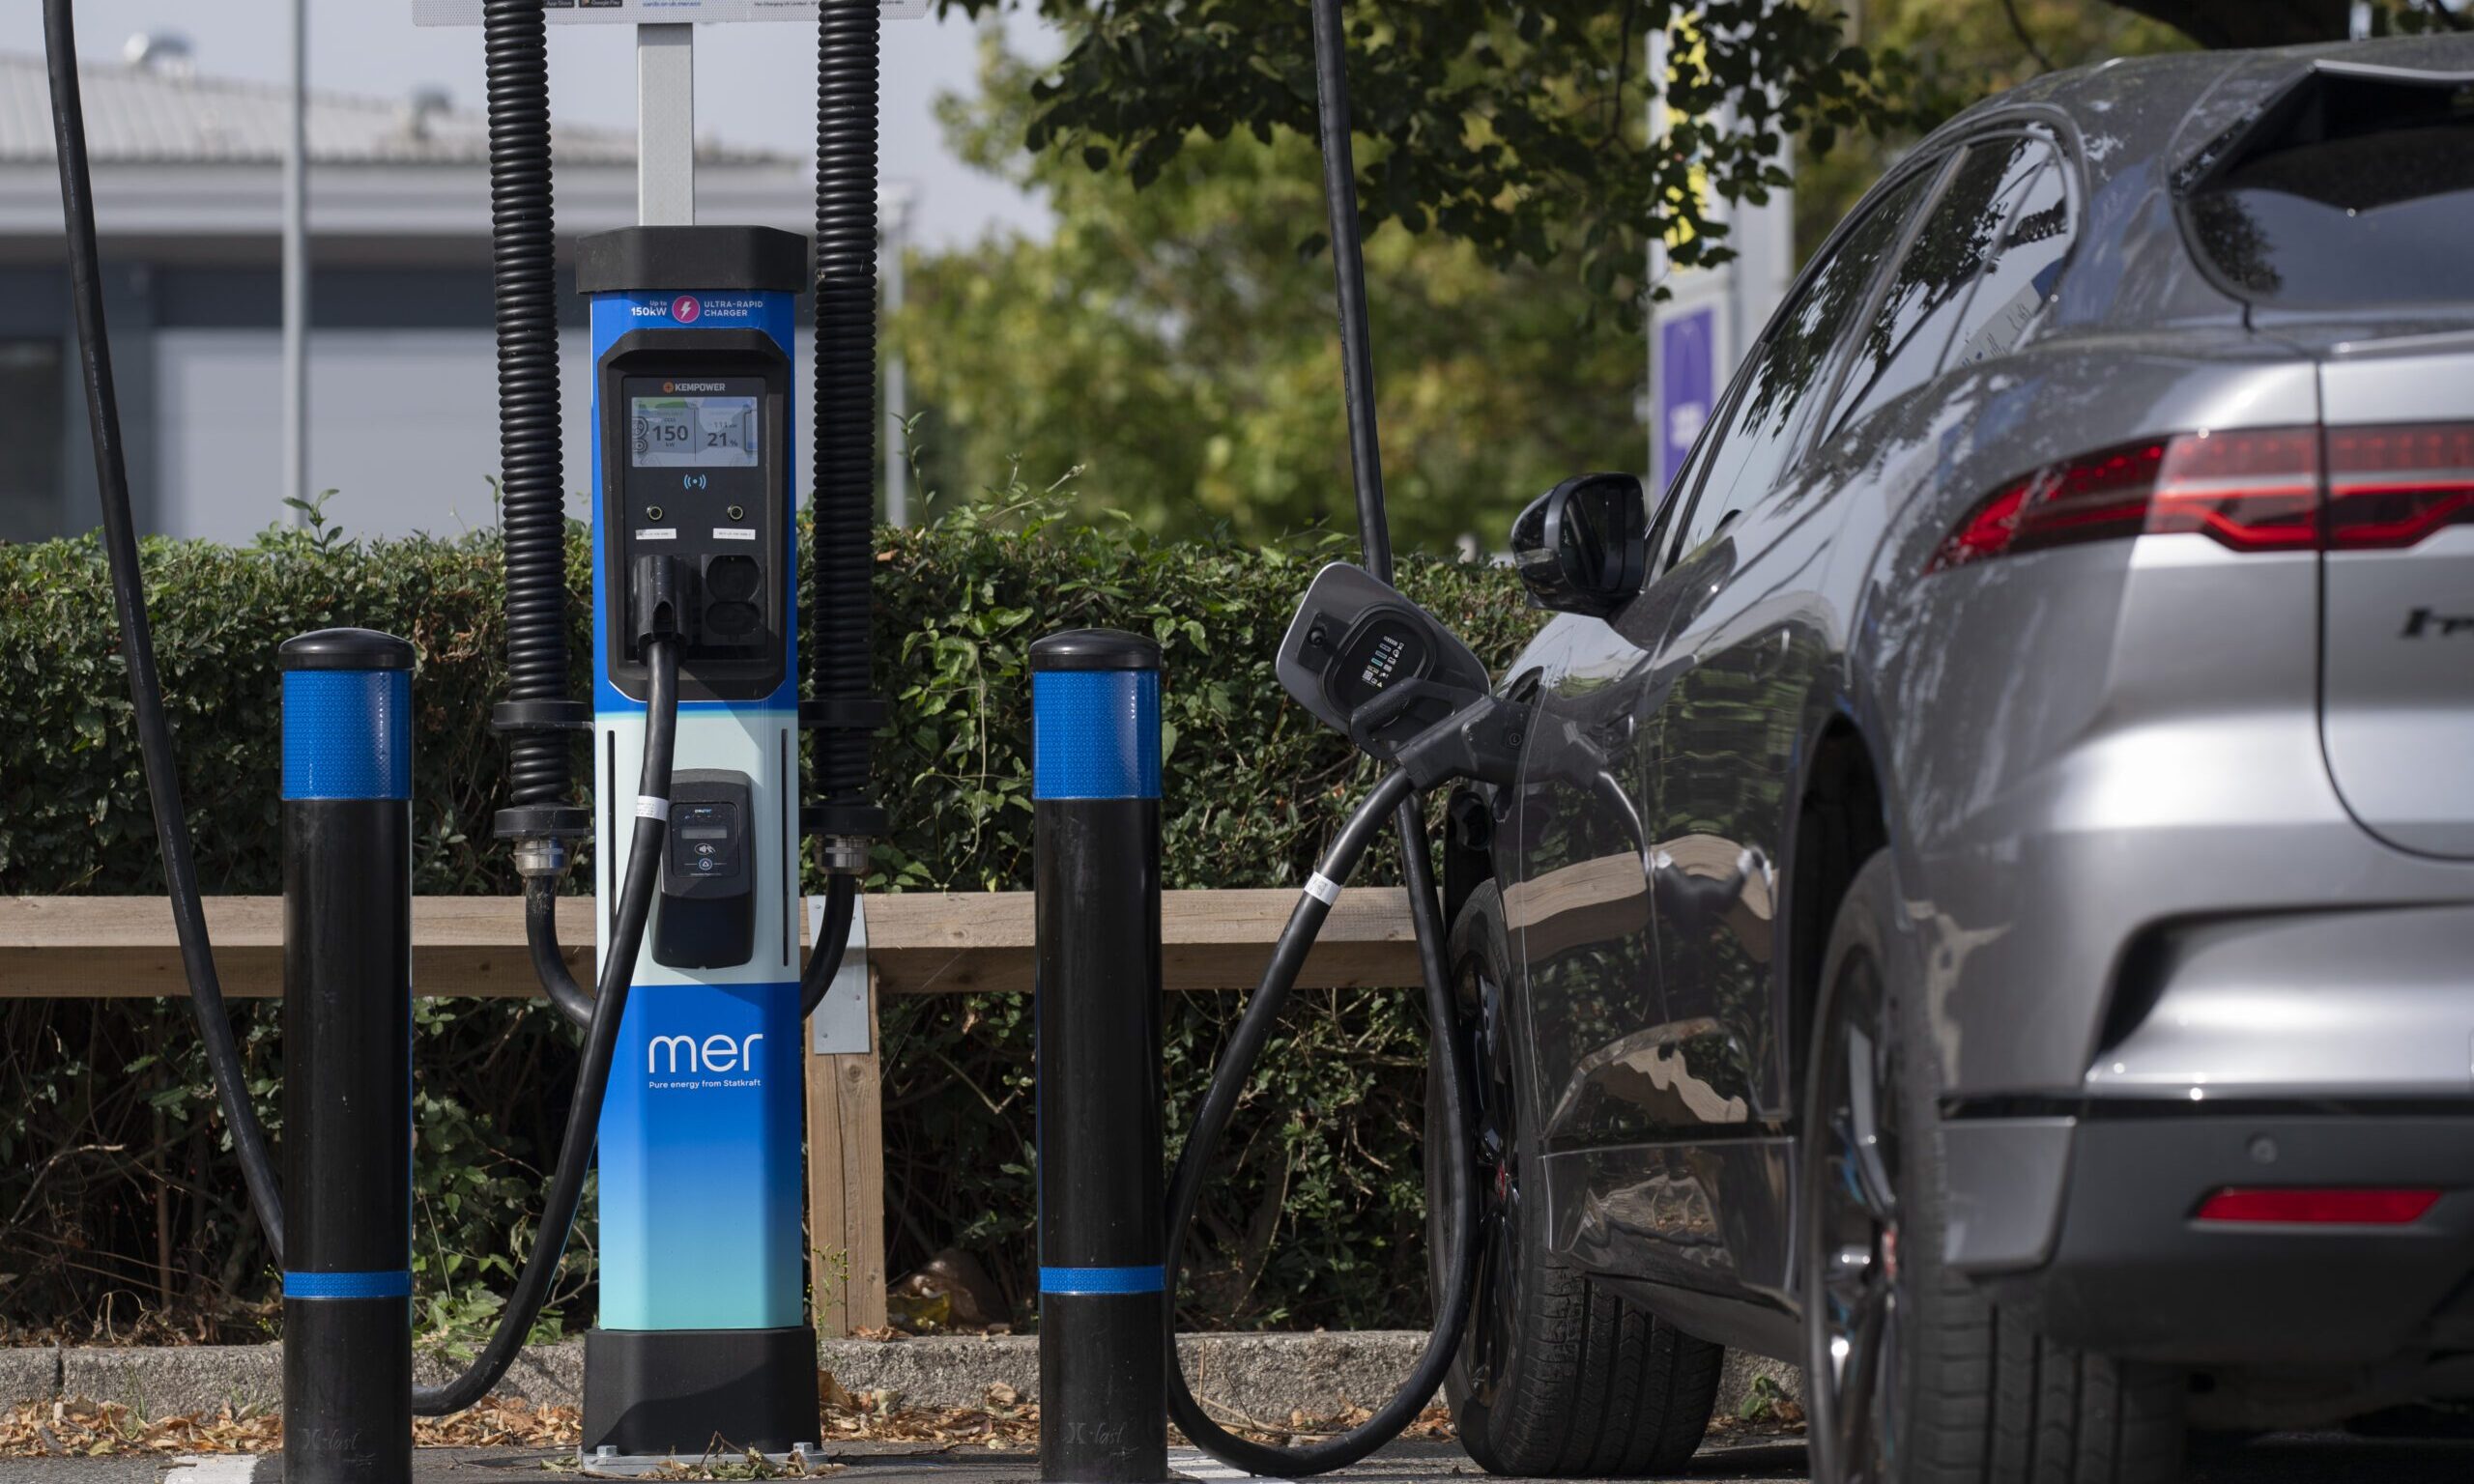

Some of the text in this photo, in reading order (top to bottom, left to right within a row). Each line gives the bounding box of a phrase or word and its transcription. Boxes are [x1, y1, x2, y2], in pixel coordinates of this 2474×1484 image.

[631, 306, 667, 316] 150kW
[675, 383, 726, 391] KEMPOWER
[652, 425, 688, 442] 150
[648, 1033, 763, 1073] mer
[670, 1081, 700, 1090] energy
[723, 1078, 761, 1087] Statkraft
